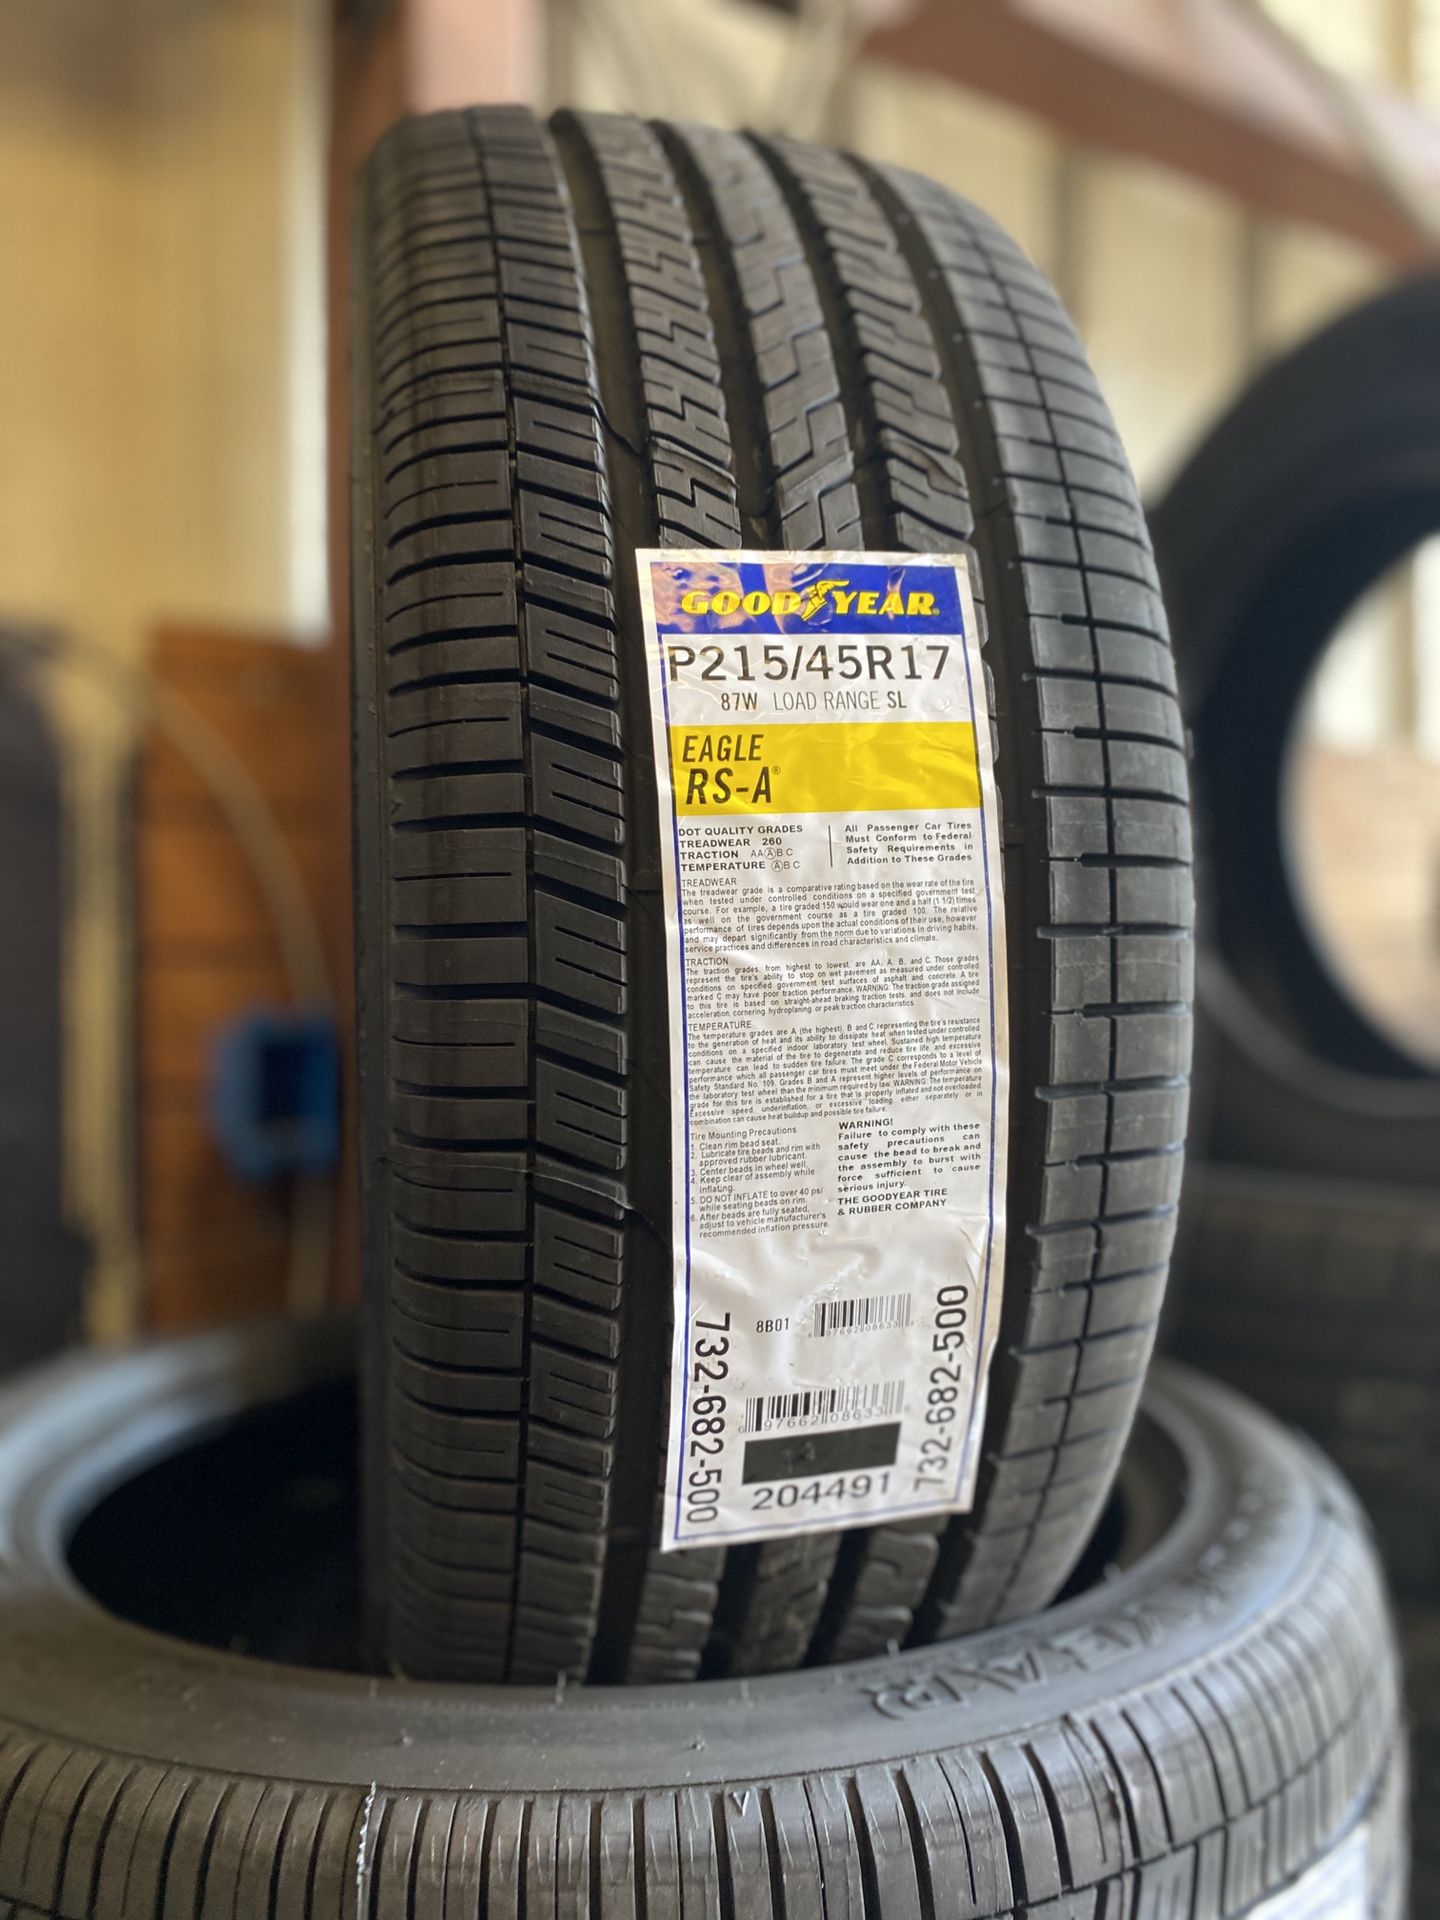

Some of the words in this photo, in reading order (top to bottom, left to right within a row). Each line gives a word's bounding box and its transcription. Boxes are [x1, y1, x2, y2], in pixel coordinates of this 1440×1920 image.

[667, 644, 950, 681] P215/45R17
[721, 692, 758, 711] 87W
[773, 692, 816, 711] LOAD
[824, 691, 880, 709] RANGE
[887, 691, 907, 708] SL
[682, 734, 764, 762] EAGLE
[679, 828, 700, 836] DOT
[705, 827, 754, 835] QUALITY
[758, 825, 803, 834] GRADES
[868, 824, 919, 833] Passenger
[680, 839, 750, 848] TREADWEAR
[762, 837, 782, 845] 260
[876, 834, 917, 842] Conform
[680, 850, 738, 860] TRACTION
[846, 846, 878, 855] Safety
[888, 844, 955, 854] Requirements
[681, 861, 766, 871] TEMPERATURE
[682, 878, 737, 887] TREADWEAR
[683, 889, 696, 897] The
[700, 887, 738, 896] treadwear
[742, 887, 763, 897] grade
[787, 885, 832, 895] comparative
[834, 882, 856, 892] rating
[858, 881, 879, 889] based
[683, 898, 704, 906] when
[710, 896, 734, 904] tested
[768, 894, 807, 902] controlled
[813, 890, 852, 901] conditions
[879, 889, 912, 900] specified
[916, 887, 958, 897] government
[686, 958, 728, 966] TRACTION
[688, 1020, 752, 1032] TEMPERATURE
[839, 1118, 893, 1130] WARNING!
[839, 1132, 872, 1140] Failure
[891, 1126, 926, 1136] comply
[929, 1124, 950, 1132] with
[954, 1122, 980, 1130] these
[691, 1133, 706, 1141] Tire
[708, 1130, 747, 1139] Mounting
[749, 1126, 797, 1136] Precautions
[700, 1142, 722, 1150] Clean
[725, 1141, 738, 1149] rim
[740, 1139, 759, 1148] bead
[838, 1142, 869, 1151] safety
[888, 1136, 944, 1149] precautions
[894, 1148, 916, 1156] bead
[933, 1145, 960, 1154] break
[702, 1150, 735, 1158] Lubricate
[738, 1148, 750, 1156] tire
[752, 1146, 774, 1154] beads
[791, 1144, 803, 1152] rim
[700, 1158, 738, 1168] approved
[740, 1155, 766, 1164] rubber
[838, 1164, 854, 1172] the
[860, 1160, 907, 1170] assembly
[929, 1156, 954, 1164] burst
[960, 1153, 980, 1161] with
[700, 1168, 726, 1176] Center
[729, 1165, 753, 1174] beads
[765, 1162, 788, 1171] wheel
[838, 1174, 863, 1182] force
[875, 1169, 921, 1179] sufficient
[952, 1164, 980, 1172] cause
[700, 1176, 720, 1185] Keep
[723, 1174, 742, 1182] clear
[746, 1173, 753, 1181] of
[755, 1170, 791, 1180] assembly
[794, 1168, 815, 1176] while
[838, 1183, 873, 1193] serious
[700, 1195, 712, 1204] DO
[715, 1194, 732, 1203] NOT
[734, 1191, 768, 1202] INFLATE
[811, 1187, 823, 1197] psi
[838, 1197, 859, 1205] THE
[862, 1190, 920, 1203] GOODYEAR
[924, 1188, 947, 1197] TIRE
[700, 1203, 721, 1212] while
[723, 1201, 752, 1211] seating
[754, 1198, 778, 1207] beads
[838, 1208, 844, 1216] &
[849, 1204, 892, 1215] RUBBER
[896, 1199, 946, 1211] COMPANY
[722, 1210, 745, 1220] beads
[762, 1207, 779, 1216] fully
[700, 1221, 724, 1231] adjust
[727, 1220, 734, 1228] to
[736, 1218, 765, 1226] vehicle
[767, 1212, 826, 1224] manufacturer's
[700, 1228, 756, 1238] recommended
[758, 1224, 790, 1233] inflation
[756, 1318, 790, 1333] 8B01
[914, 1285, 969, 1492] 732-682-500
[687, 1312, 731, 1524] 732-682-500
[751, 1472, 891, 1511] 204491
